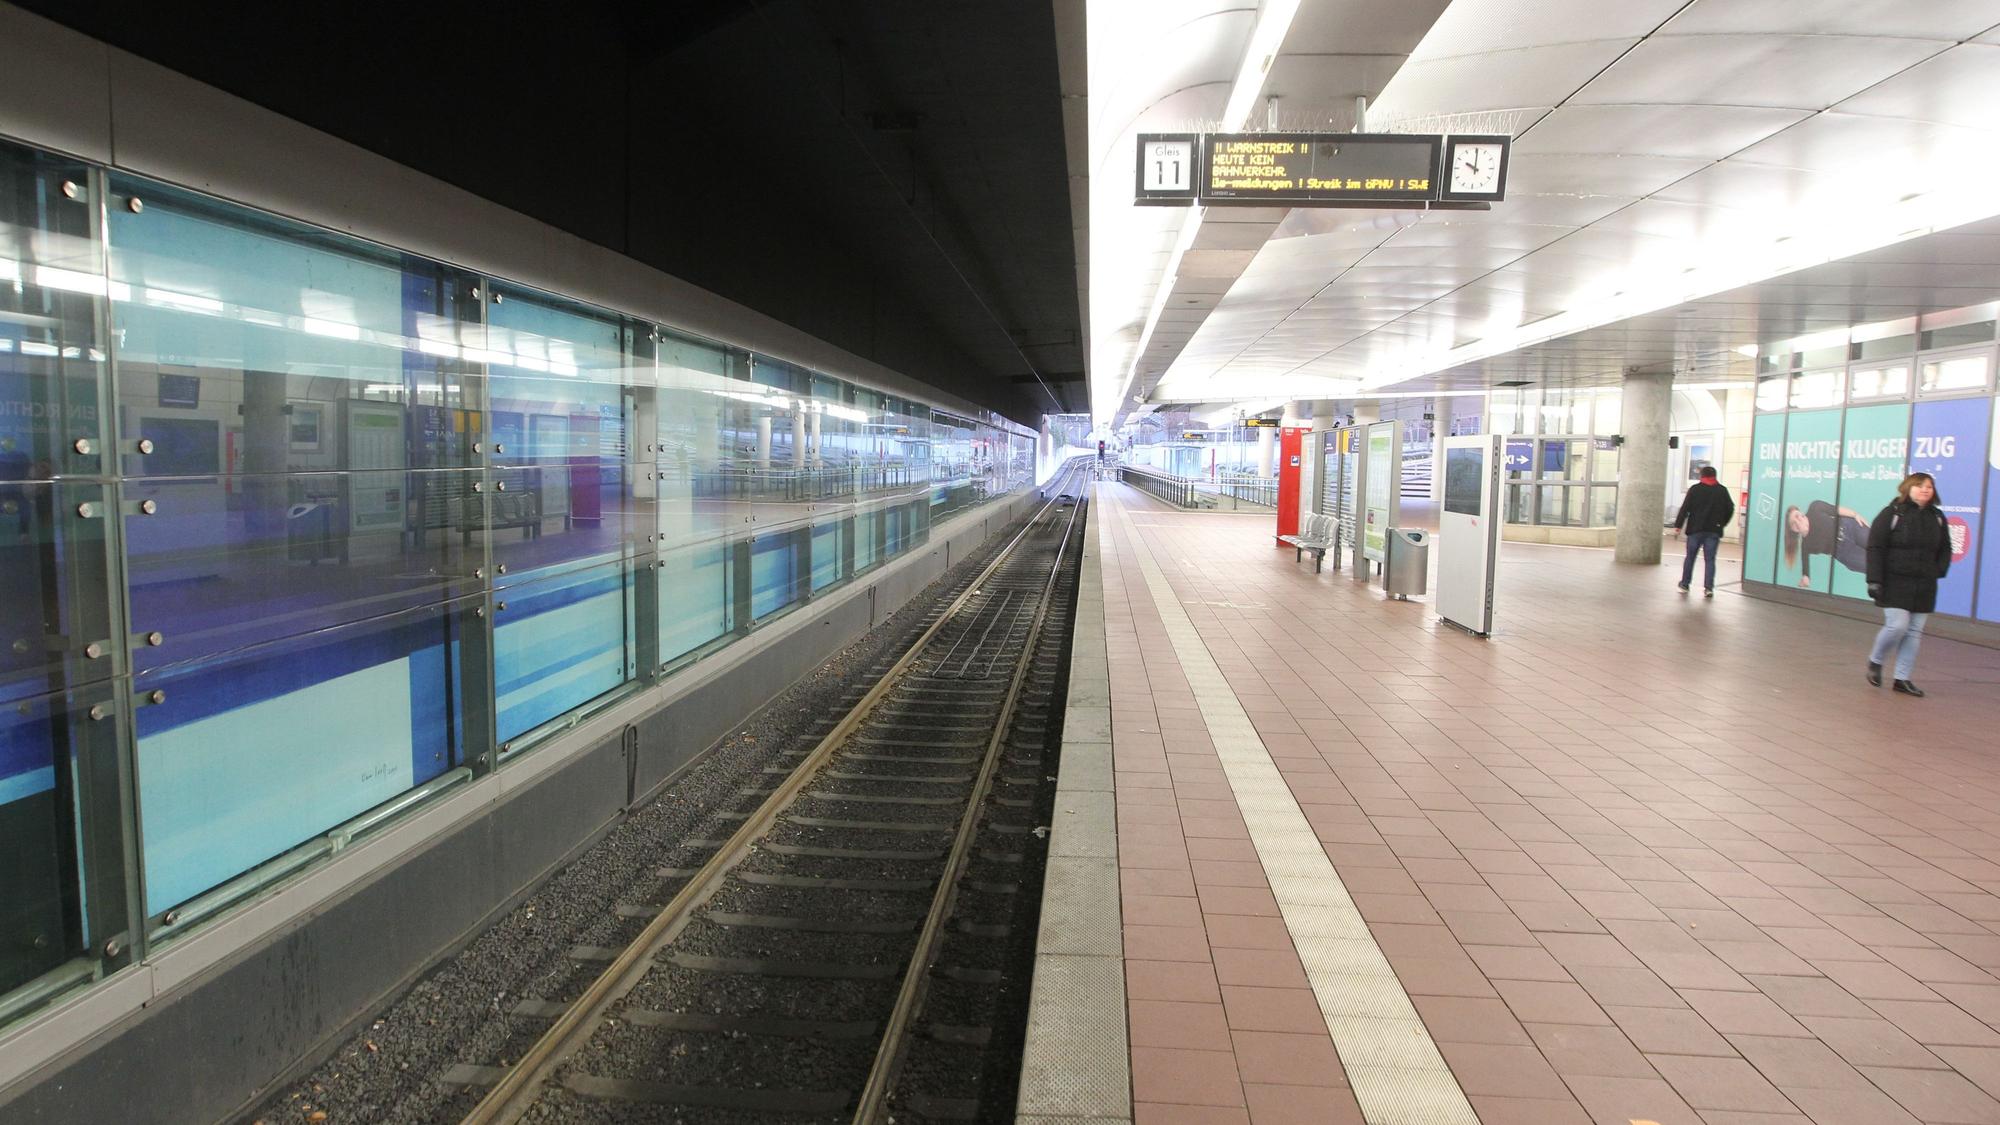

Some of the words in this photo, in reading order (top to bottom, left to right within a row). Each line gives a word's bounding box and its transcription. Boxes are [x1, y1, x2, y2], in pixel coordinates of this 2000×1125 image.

[1155, 144, 1180, 157] Gleis
[1227, 143, 1294, 154] WARNSTREIK
[1213, 154, 1245, 165] HEUTE
[1250, 154, 1275, 165] KEIN
[1156, 160, 1180, 185] 11
[1212, 166, 1287, 177] BAHNVERKEHR.
[1306, 178, 1342, 189] Streik
[1346, 179, 1361, 189] im
[1760, 442, 1782, 460] EIN
[1786, 440, 1841, 460] RICHTIG
[1848, 438, 1907, 459] KLUGER
[1914, 436, 1955, 458] ZUG
